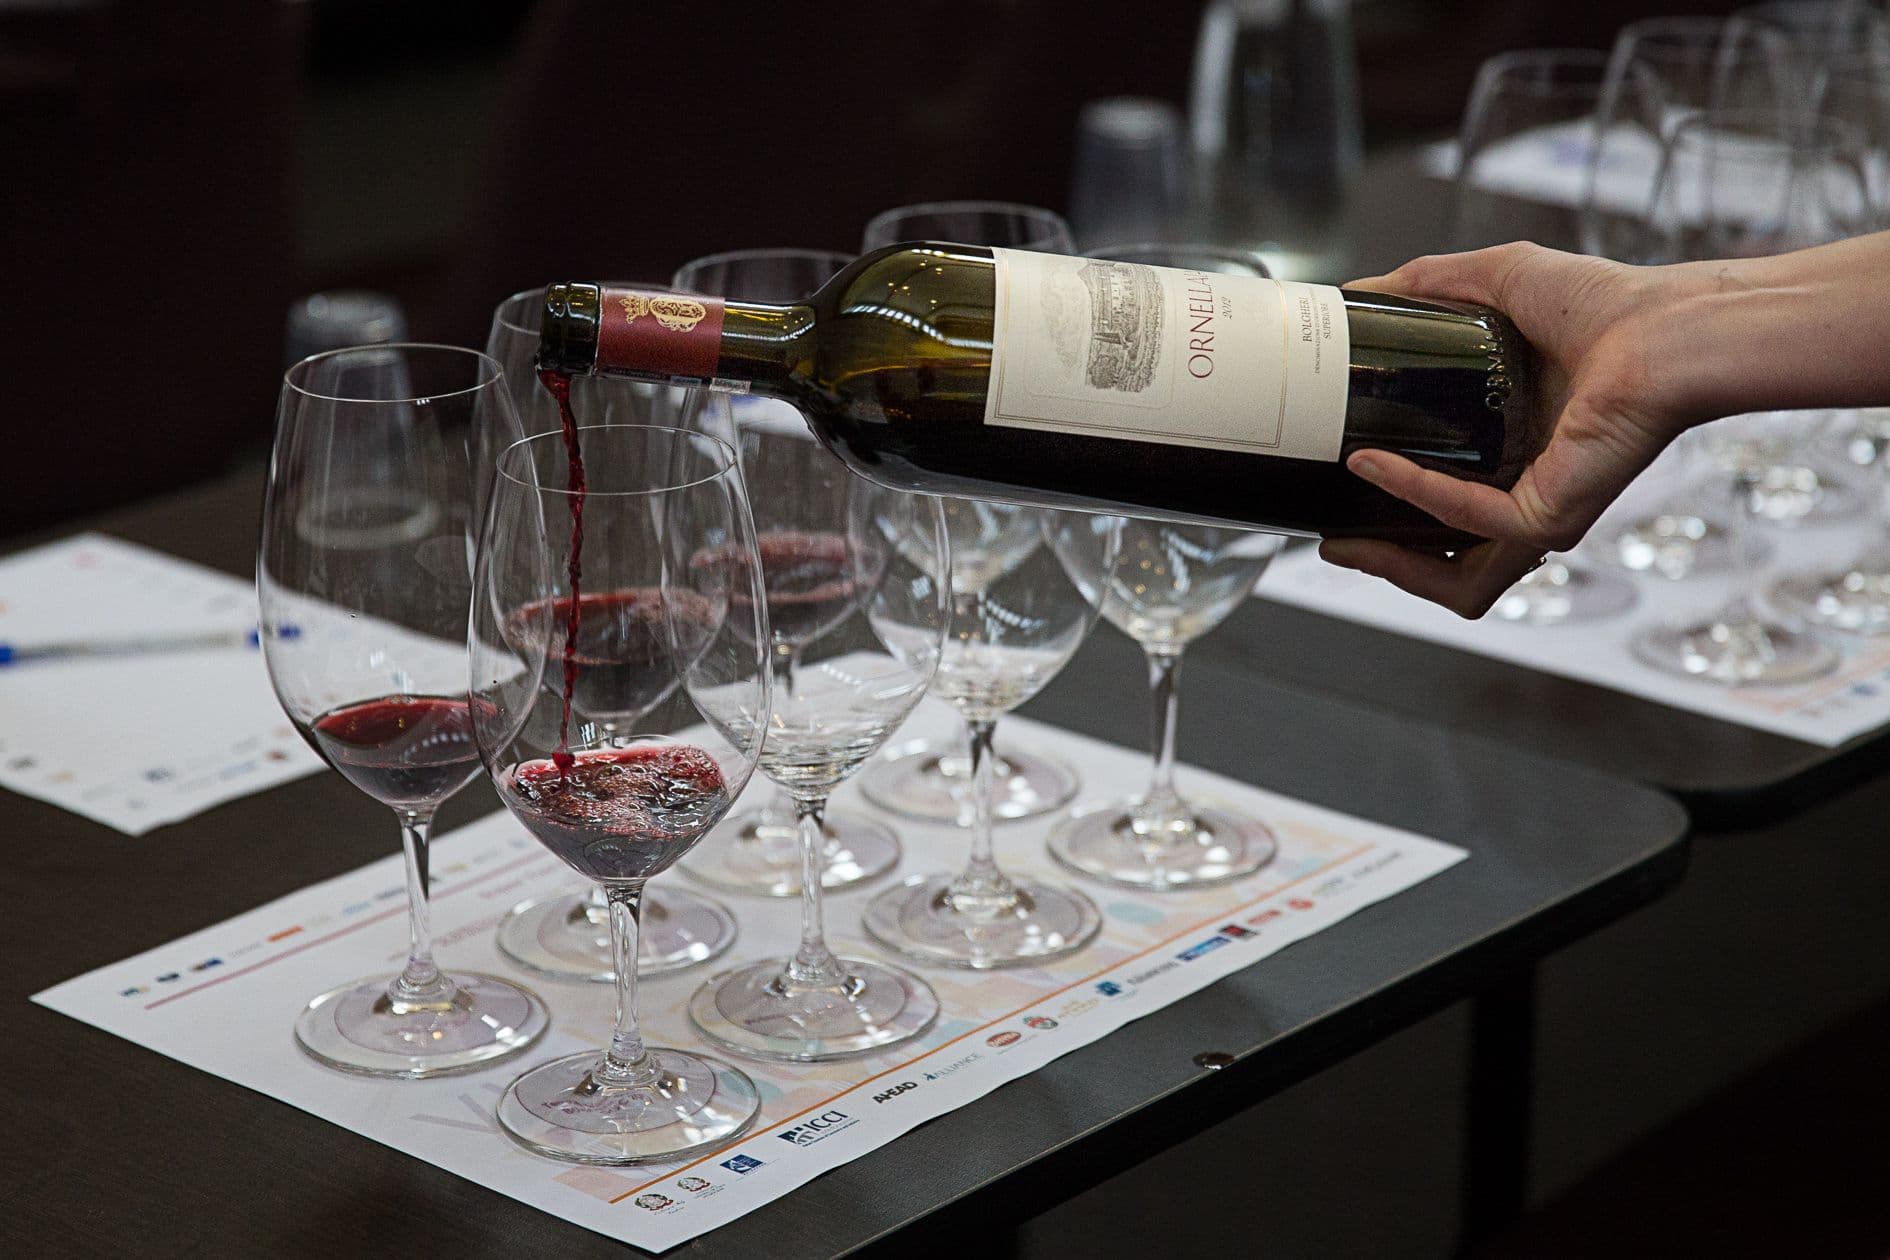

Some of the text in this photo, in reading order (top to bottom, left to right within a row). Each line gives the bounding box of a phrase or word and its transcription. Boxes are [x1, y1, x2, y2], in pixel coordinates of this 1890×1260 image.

[1221, 297, 1233, 320] 2012
[1299, 296, 1313, 343] BOLGHERI
[872, 1081, 918, 1104] AHEAD
[805, 1110, 849, 1133] ICCI
